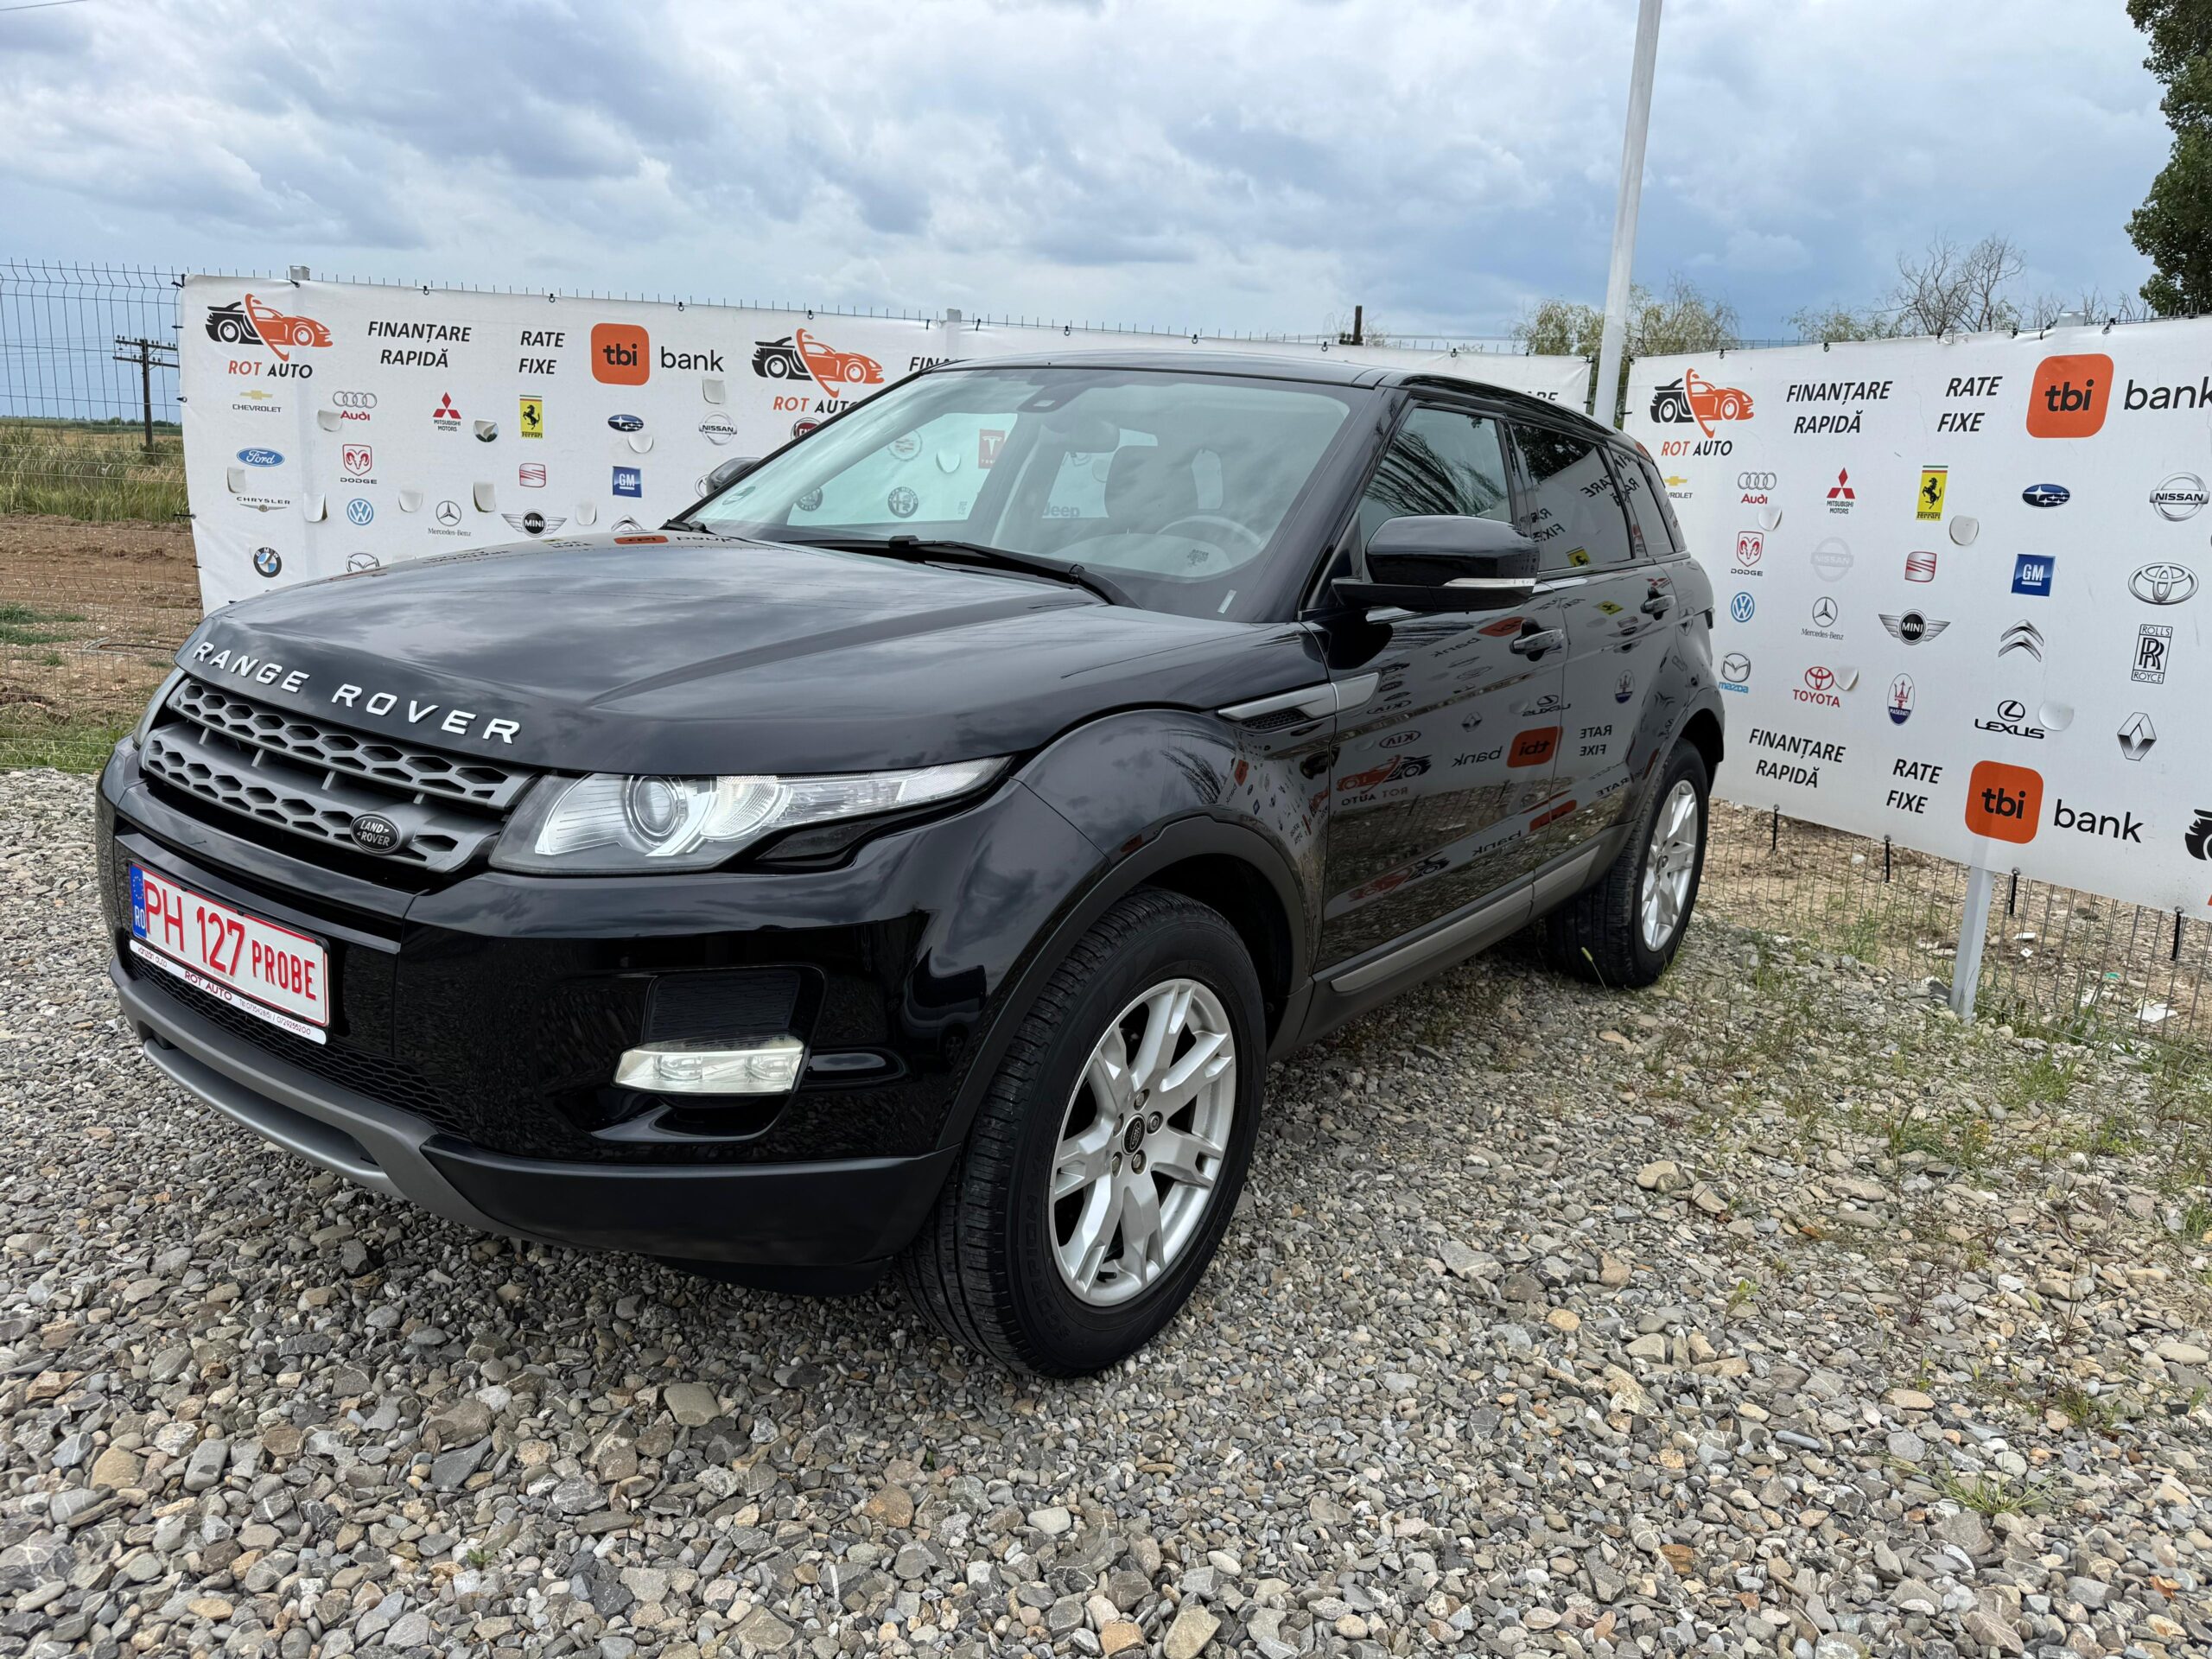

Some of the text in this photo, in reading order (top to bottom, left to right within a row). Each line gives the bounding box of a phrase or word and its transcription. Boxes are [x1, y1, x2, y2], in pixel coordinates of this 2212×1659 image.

[367, 321, 472, 342] FINANȚARE
[520, 331, 565, 348] RATE
[380, 349, 449, 368] RAPIDĂ
[602, 342, 724, 372] tbi bank
[228, 360, 313, 378] ROT AUTO
[518, 358, 556, 375] FIXE
[1785, 381, 1893, 404] FINANȚARE
[1946, 376, 2003, 397] RATE
[2044, 376, 2212, 411] tbi bank
[232, 404, 282, 413] CHEVROLET
[773, 396, 810, 412] ROT
[340, 410, 371, 421] Audi
[1793, 410, 1864, 434] RAPIDĂ
[1937, 412, 1985, 432] FIXE
[702, 424, 734, 433] NISSAN
[246, 448, 276, 464] Ford
[1661, 440, 1732, 456] ROT AUTO
[619, 474, 635, 486] GM
[237, 496, 290, 505] CHRYSLER
[1741, 493, 1768, 505] Audi
[2155, 492, 2204, 502] NISSAN
[524, 519, 544, 528] MINI
[428, 528, 472, 537] Mercedes-Benz
[1731, 569, 1764, 577] DODGE
[2022, 563, 2044, 582] GM
[1802, 628, 1844, 640] Mercedes-Benz
[1902, 621, 1923, 633] MINI
[2142, 626, 2171, 636] ROLLS
[2133, 671, 2162, 683] ROYCE
[192, 641, 522, 745] RANGE ROVER
[1718, 681, 1749, 694] mazda
[1793, 689, 1840, 708] TOYOTA
[1974, 718, 2044, 740] LEXUS
[1749, 728, 1846, 763] FINANȚARE
[1756, 759, 1820, 788] RAPIDĂ
[1892, 759, 1943, 785] RATE
[1886, 790, 1929, 814] FIXE
[1981, 787, 2144, 843] tbi bank
[360, 820, 385, 834] LAND
[360, 831, 391, 847] ROVER
[134, 905, 145, 930] RO
[144, 879, 317, 1001] PH 127 PROBE
[185, 970, 203, 987] ROT
[206, 983, 232, 1001] AUTO
